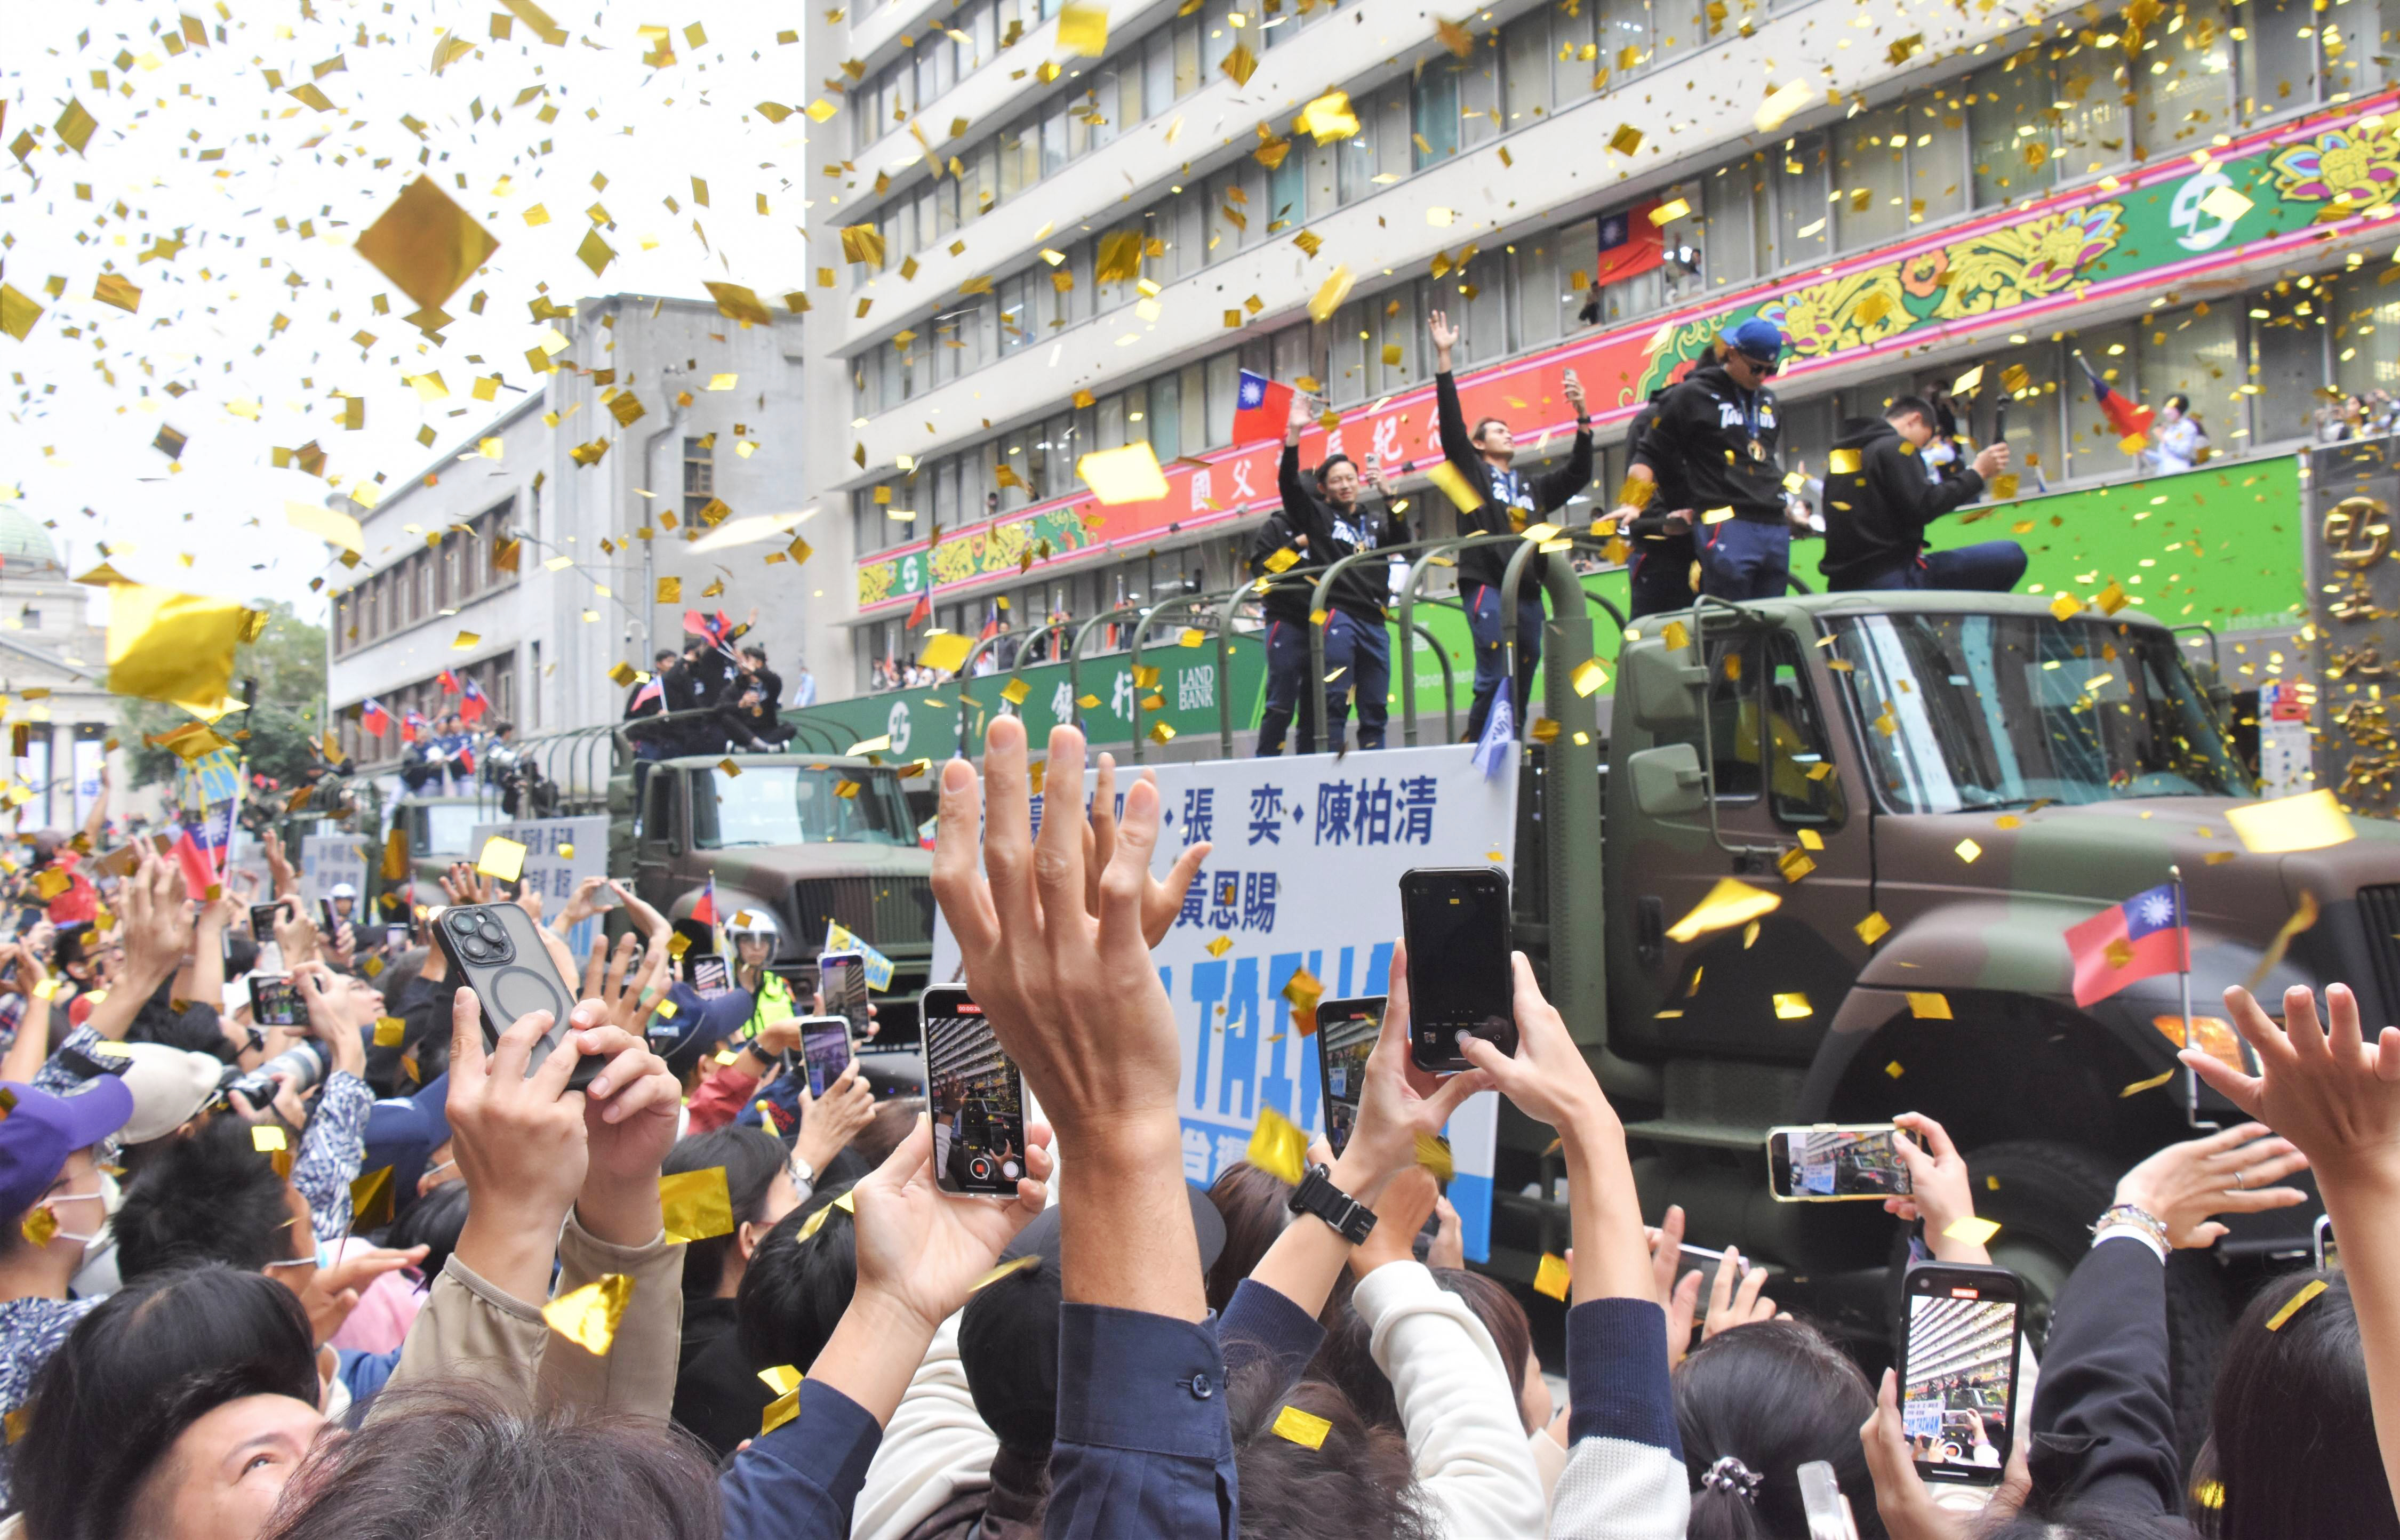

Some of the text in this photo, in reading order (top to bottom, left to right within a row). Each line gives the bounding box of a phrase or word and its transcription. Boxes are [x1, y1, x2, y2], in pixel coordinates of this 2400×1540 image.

[1178, 665, 1214, 688] LAND
[1178, 687, 1214, 710] BANK
[1315, 775, 1437, 846] 陳柏清
[1175, 869, 1277, 933] 黃恩賜
